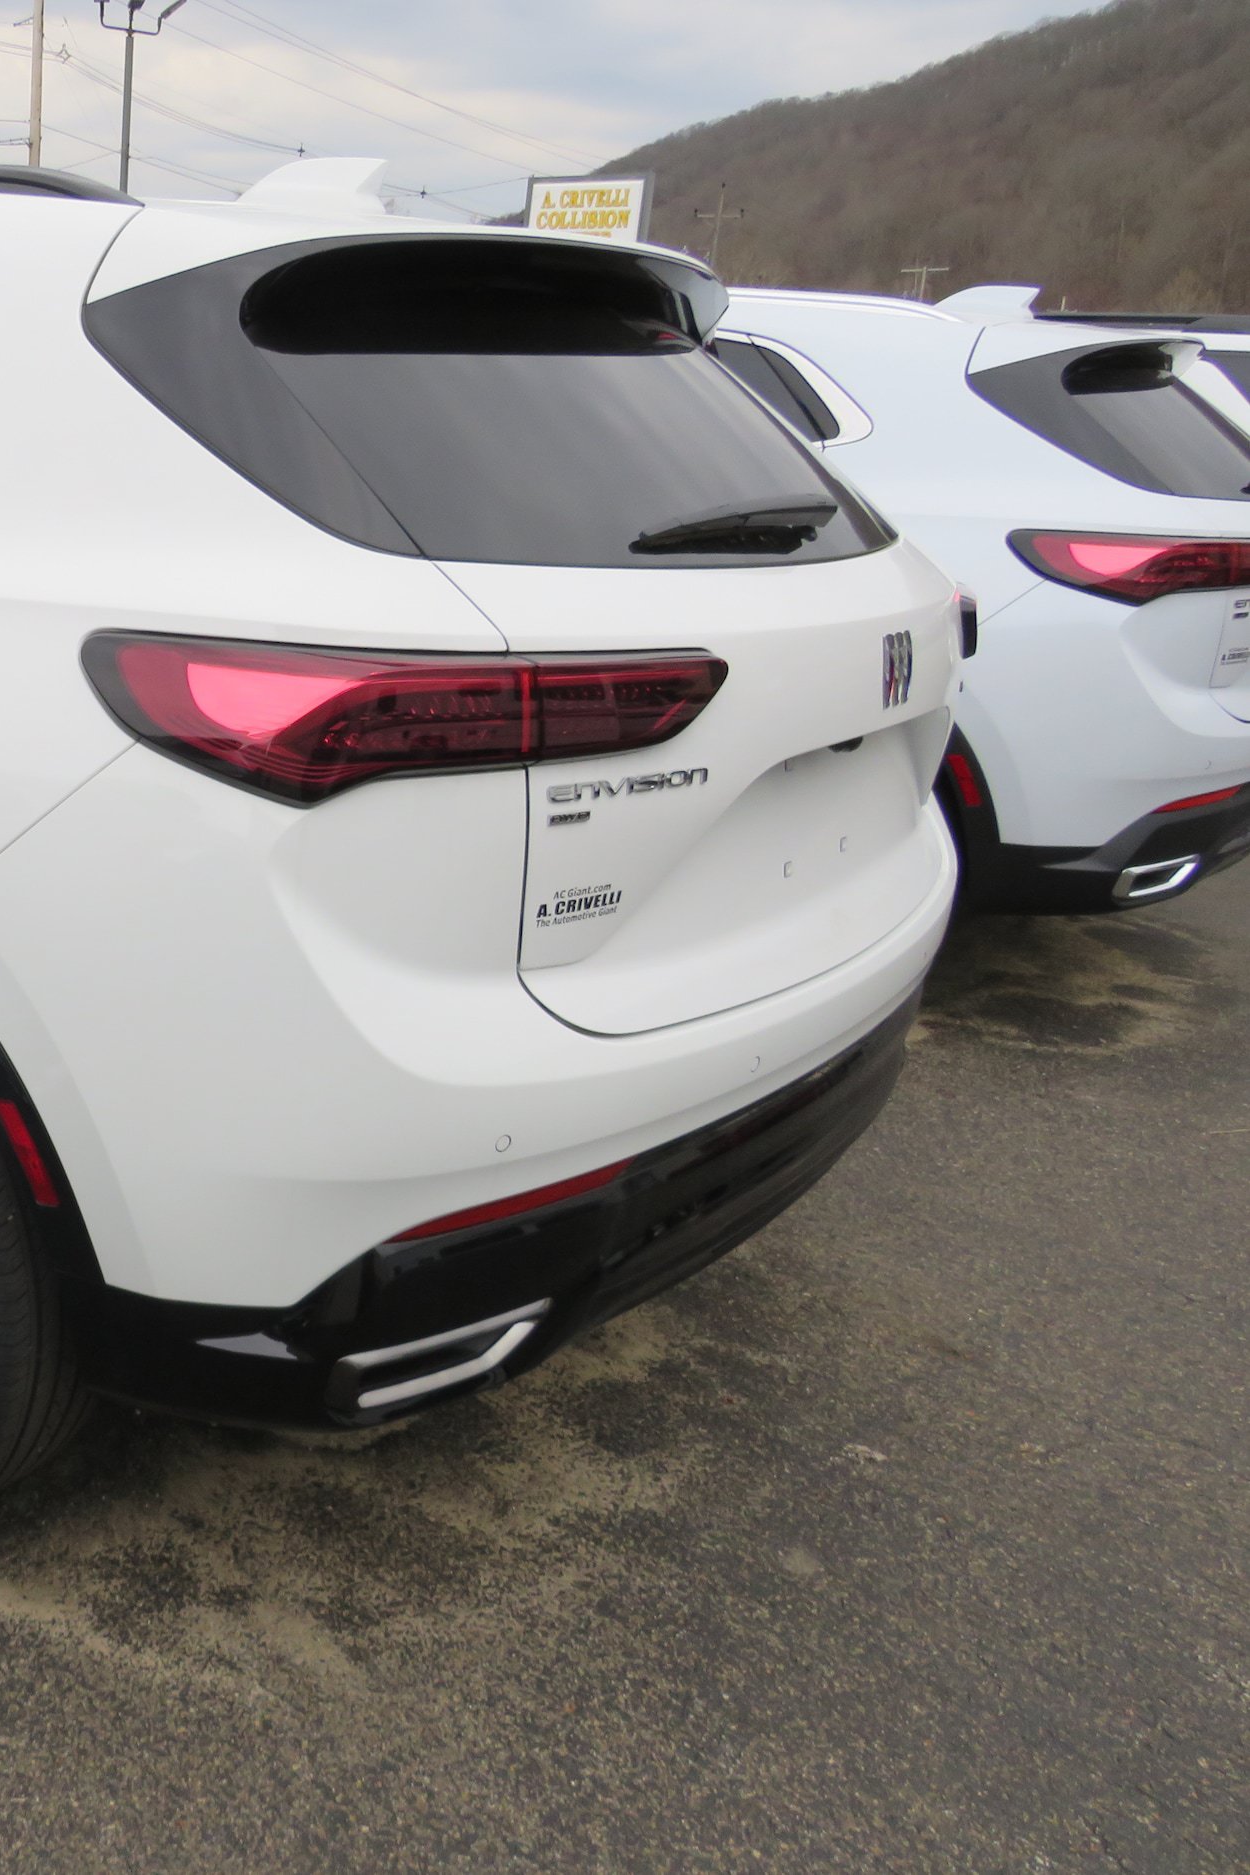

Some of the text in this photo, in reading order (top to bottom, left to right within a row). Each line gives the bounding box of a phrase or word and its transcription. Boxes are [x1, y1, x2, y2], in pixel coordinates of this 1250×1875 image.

[541, 188, 631, 209] A. CRIVELLI
[536, 210, 631, 230] COLLISION
[567, 883, 612, 898] Giant.com
[536, 890, 622, 919] A. CRIVELLI
[535, 905, 618, 928] The Automotive Giant
